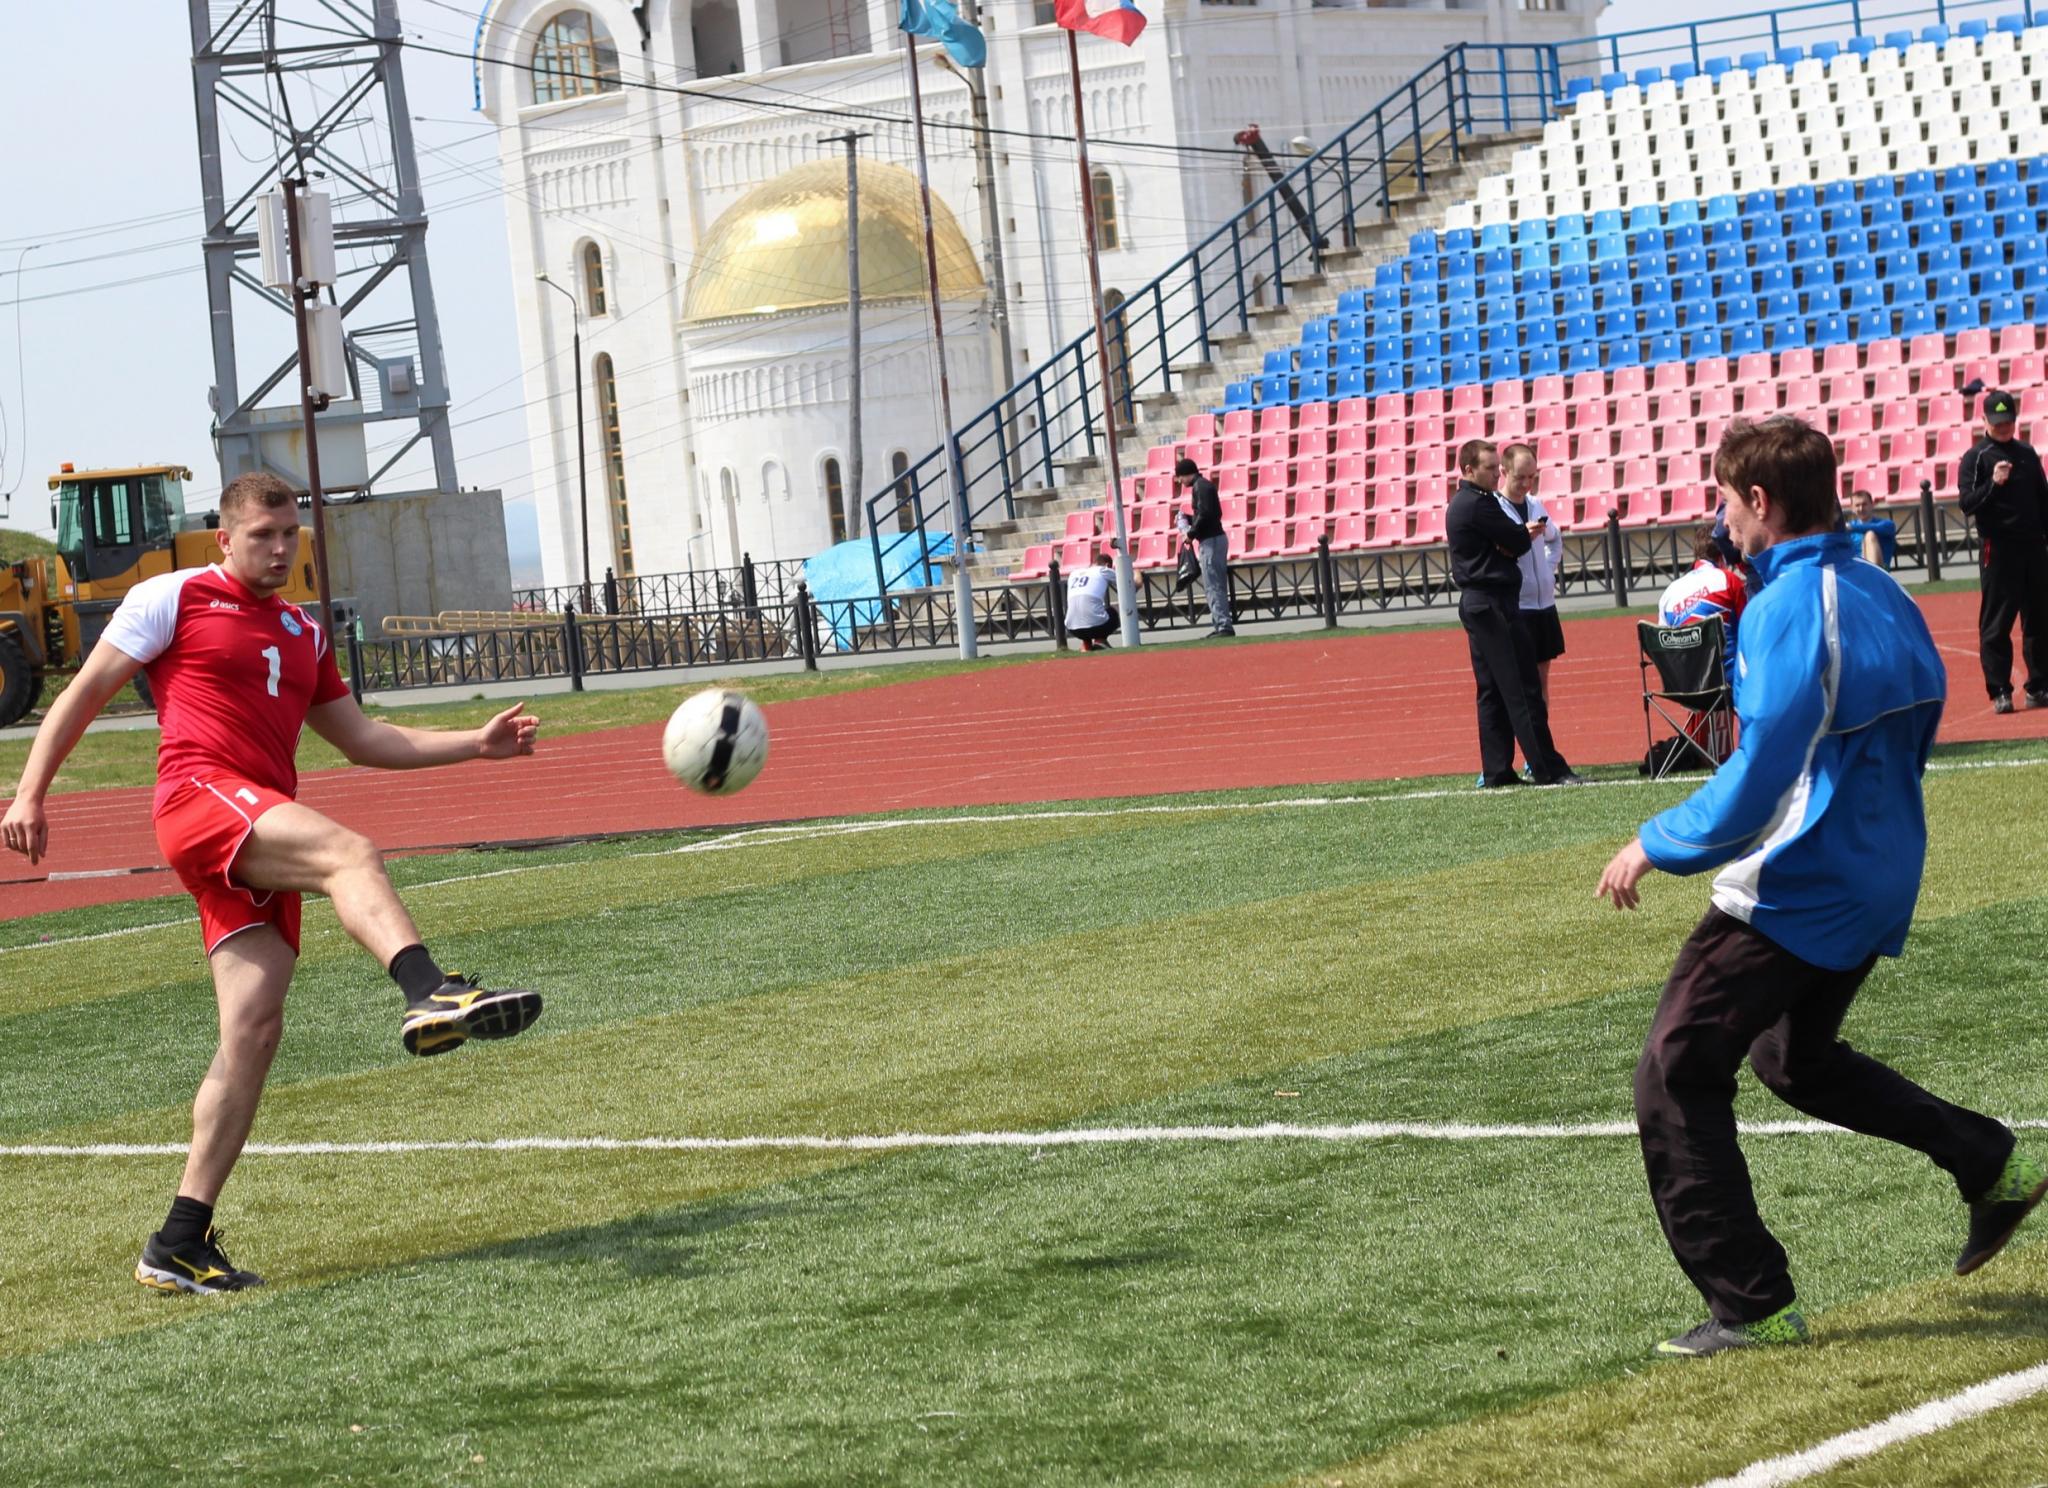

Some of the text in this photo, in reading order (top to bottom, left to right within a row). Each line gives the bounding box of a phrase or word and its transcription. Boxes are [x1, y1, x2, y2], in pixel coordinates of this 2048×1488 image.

[1070, 575, 1091, 590] 29
[219, 601, 240, 611] asics
[1672, 585, 1710, 616] RUSSIA
[1661, 630, 1693, 644] Coleman
[262, 646, 281, 697] 1
[235, 787, 260, 806] 1
